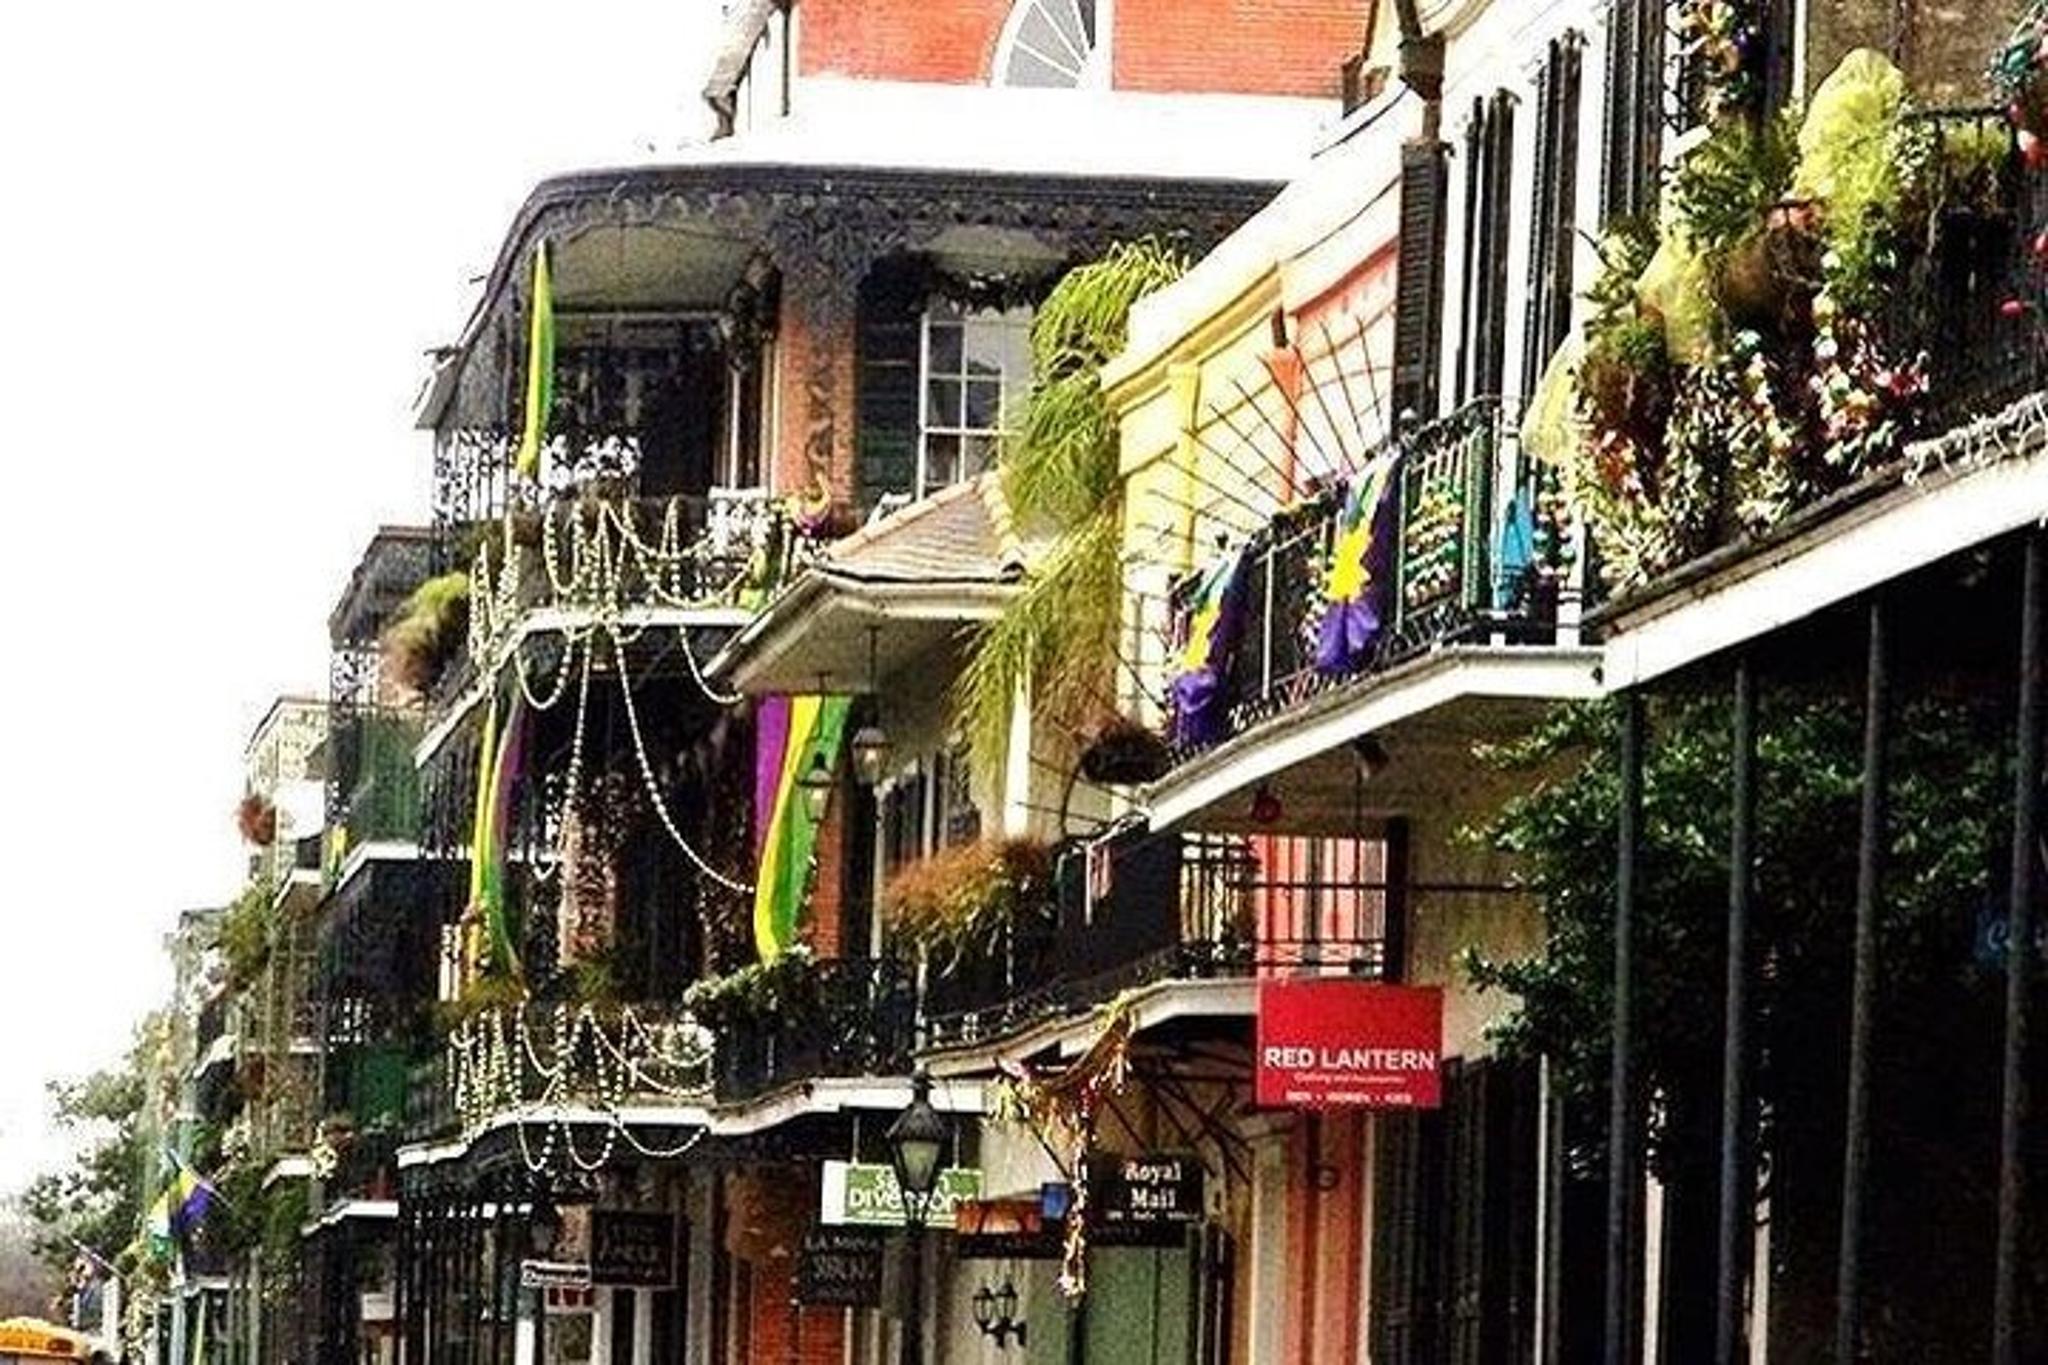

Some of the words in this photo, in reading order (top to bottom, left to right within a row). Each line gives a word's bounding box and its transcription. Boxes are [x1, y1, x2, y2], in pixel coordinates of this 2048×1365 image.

[1264, 1046, 1315, 1068] RED
[1321, 1047, 1435, 1071] LANTERN
[1125, 1160, 1181, 1186] Royal
